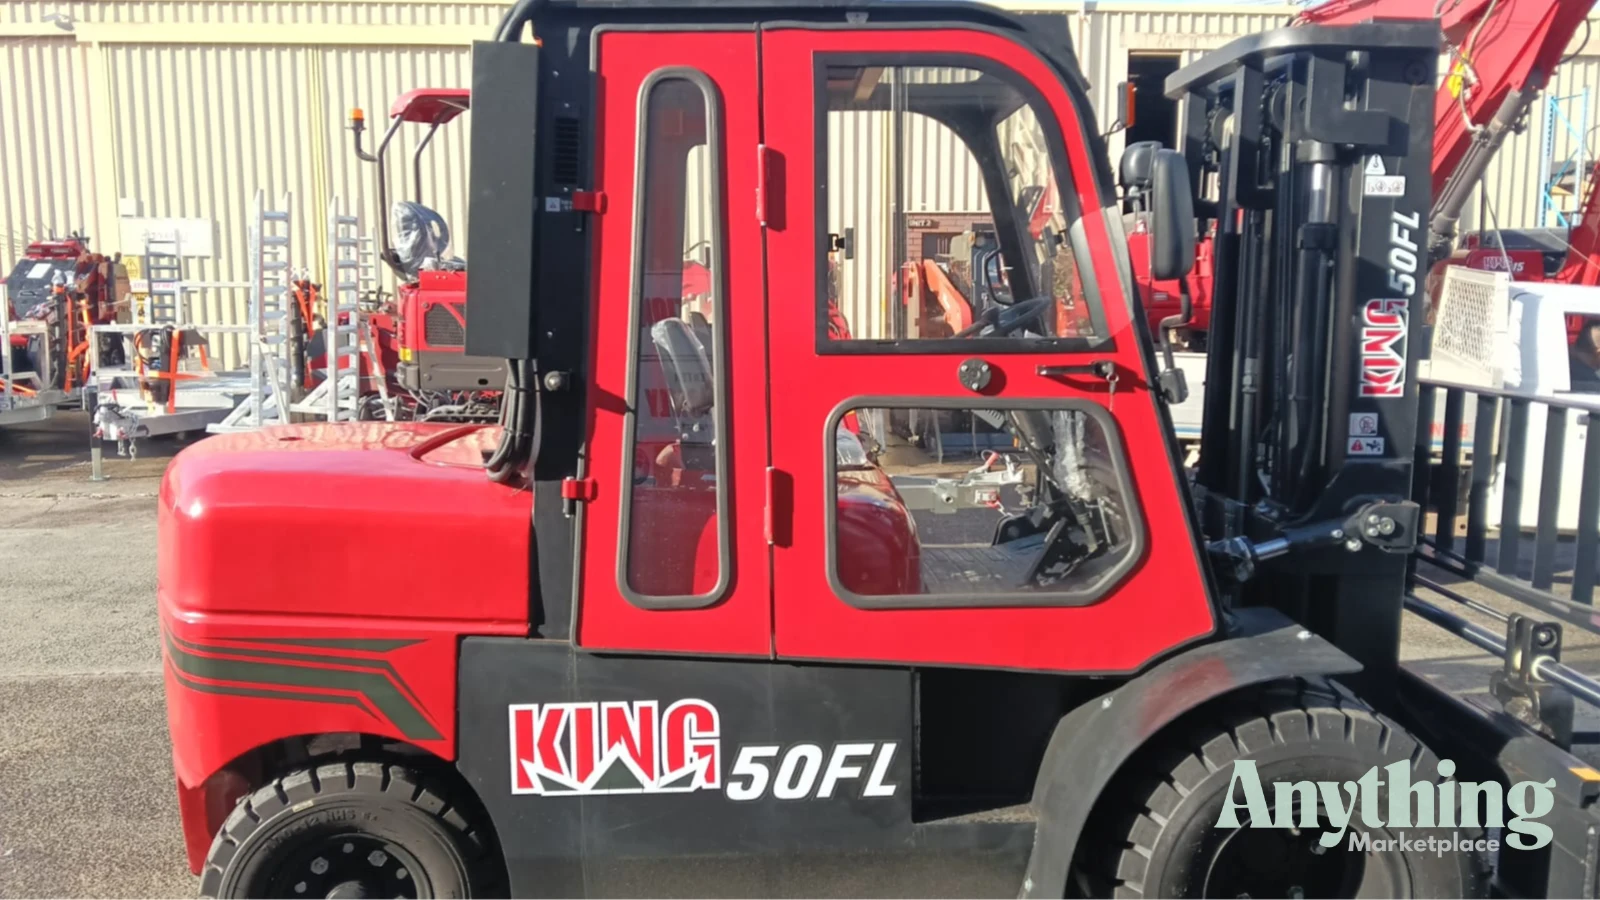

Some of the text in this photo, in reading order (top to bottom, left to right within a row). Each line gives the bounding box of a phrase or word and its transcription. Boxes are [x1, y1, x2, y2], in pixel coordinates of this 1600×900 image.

[1359, 211, 1420, 397] KING 50FL
[1513, 262, 1525, 271] 15
[508, 698, 898, 801] KING 50FL
